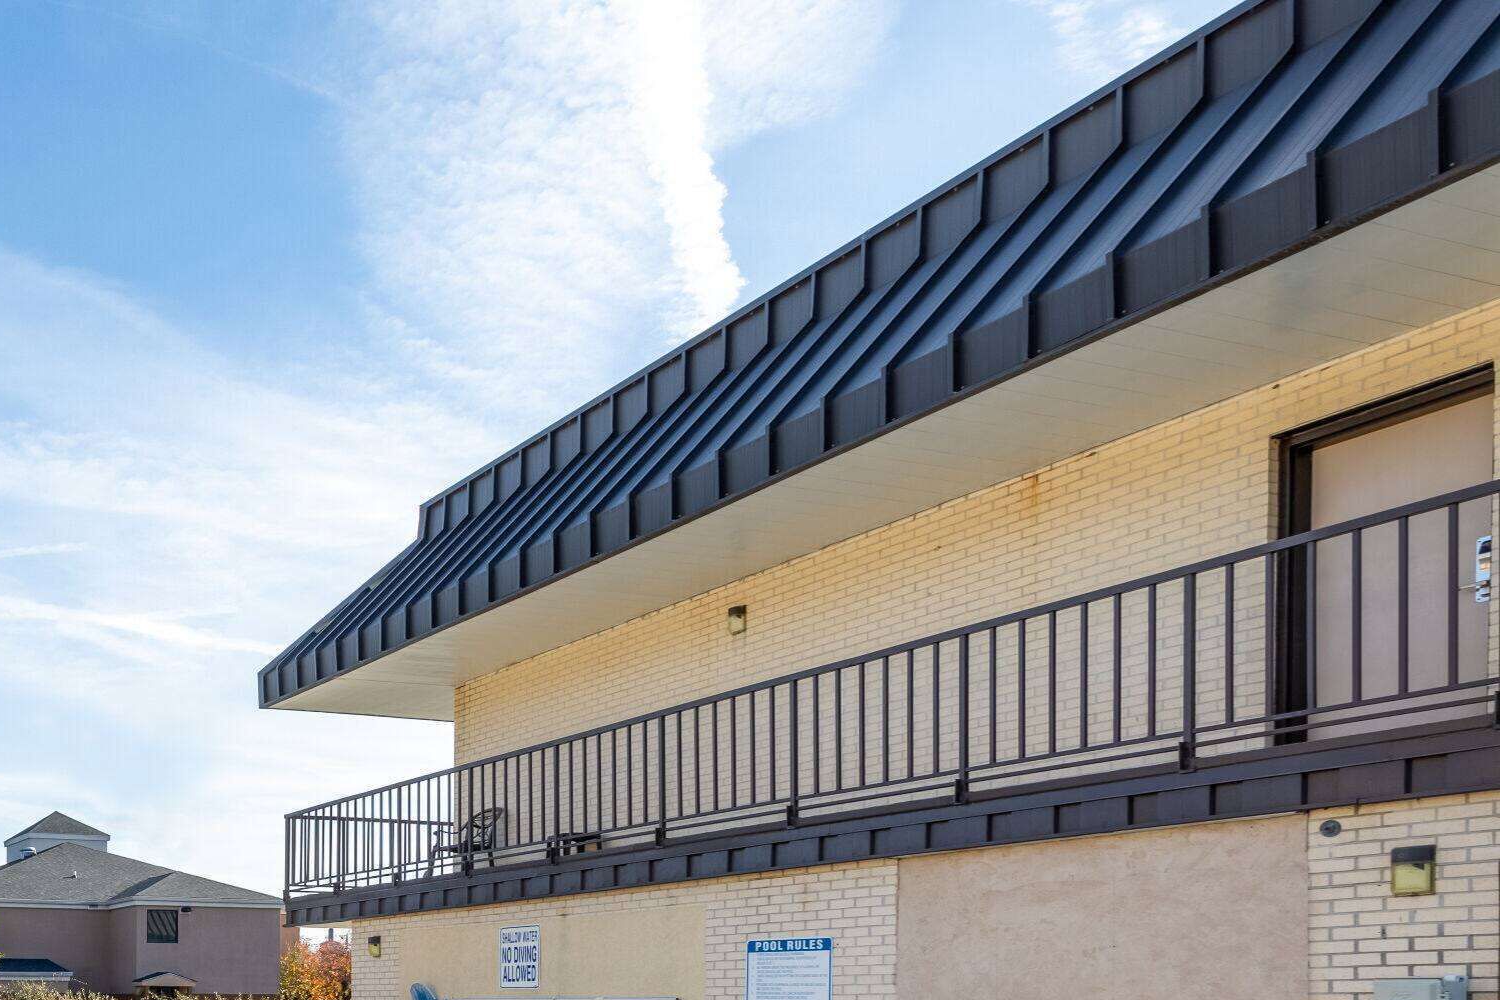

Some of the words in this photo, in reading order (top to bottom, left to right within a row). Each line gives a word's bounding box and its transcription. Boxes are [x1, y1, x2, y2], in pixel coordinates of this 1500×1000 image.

[522, 930, 538, 942] WATER
[755, 941, 783, 952] POOL
[786, 939, 824, 951] RULES
[502, 946, 512, 963] NO
[513, 945, 537, 963] DIVING
[503, 965, 536, 982] ALLOWED
